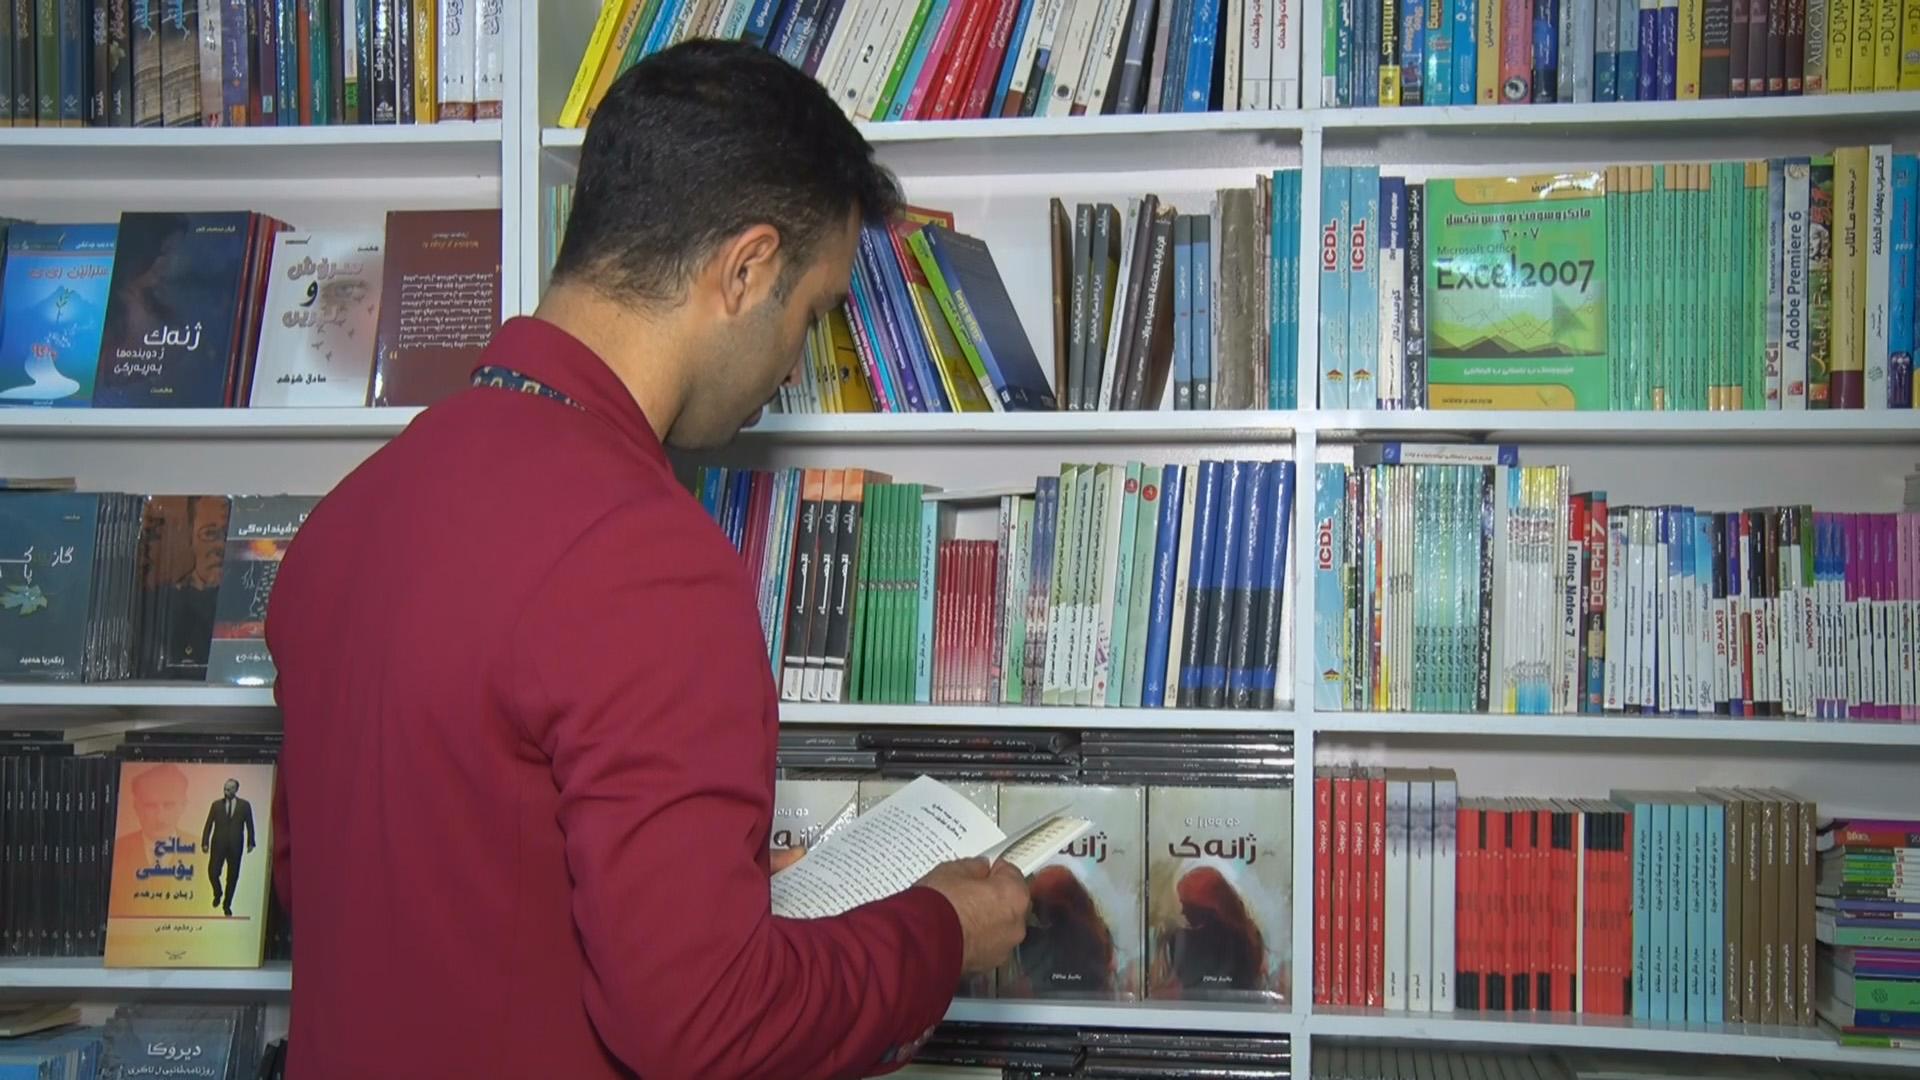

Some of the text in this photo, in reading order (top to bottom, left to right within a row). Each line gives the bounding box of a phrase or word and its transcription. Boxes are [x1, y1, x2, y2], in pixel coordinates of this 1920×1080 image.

[1323, 219, 1336, 272] ICDL
[1351, 219, 1365, 272] ICDL
[1436, 243, 1517, 257] Microsoft Office
[1436, 252, 1595, 293] Excel 2007
[1786, 211, 1801, 350] Adobe Premiere 6
[1319, 517, 1332, 570] ICDL
[1590, 517, 1605, 606] DELPHI 7
[1717, 642, 1725, 656] 3D
[1757, 642, 1764, 655] 3D
[1806, 610, 1814, 649] WINDOWS
